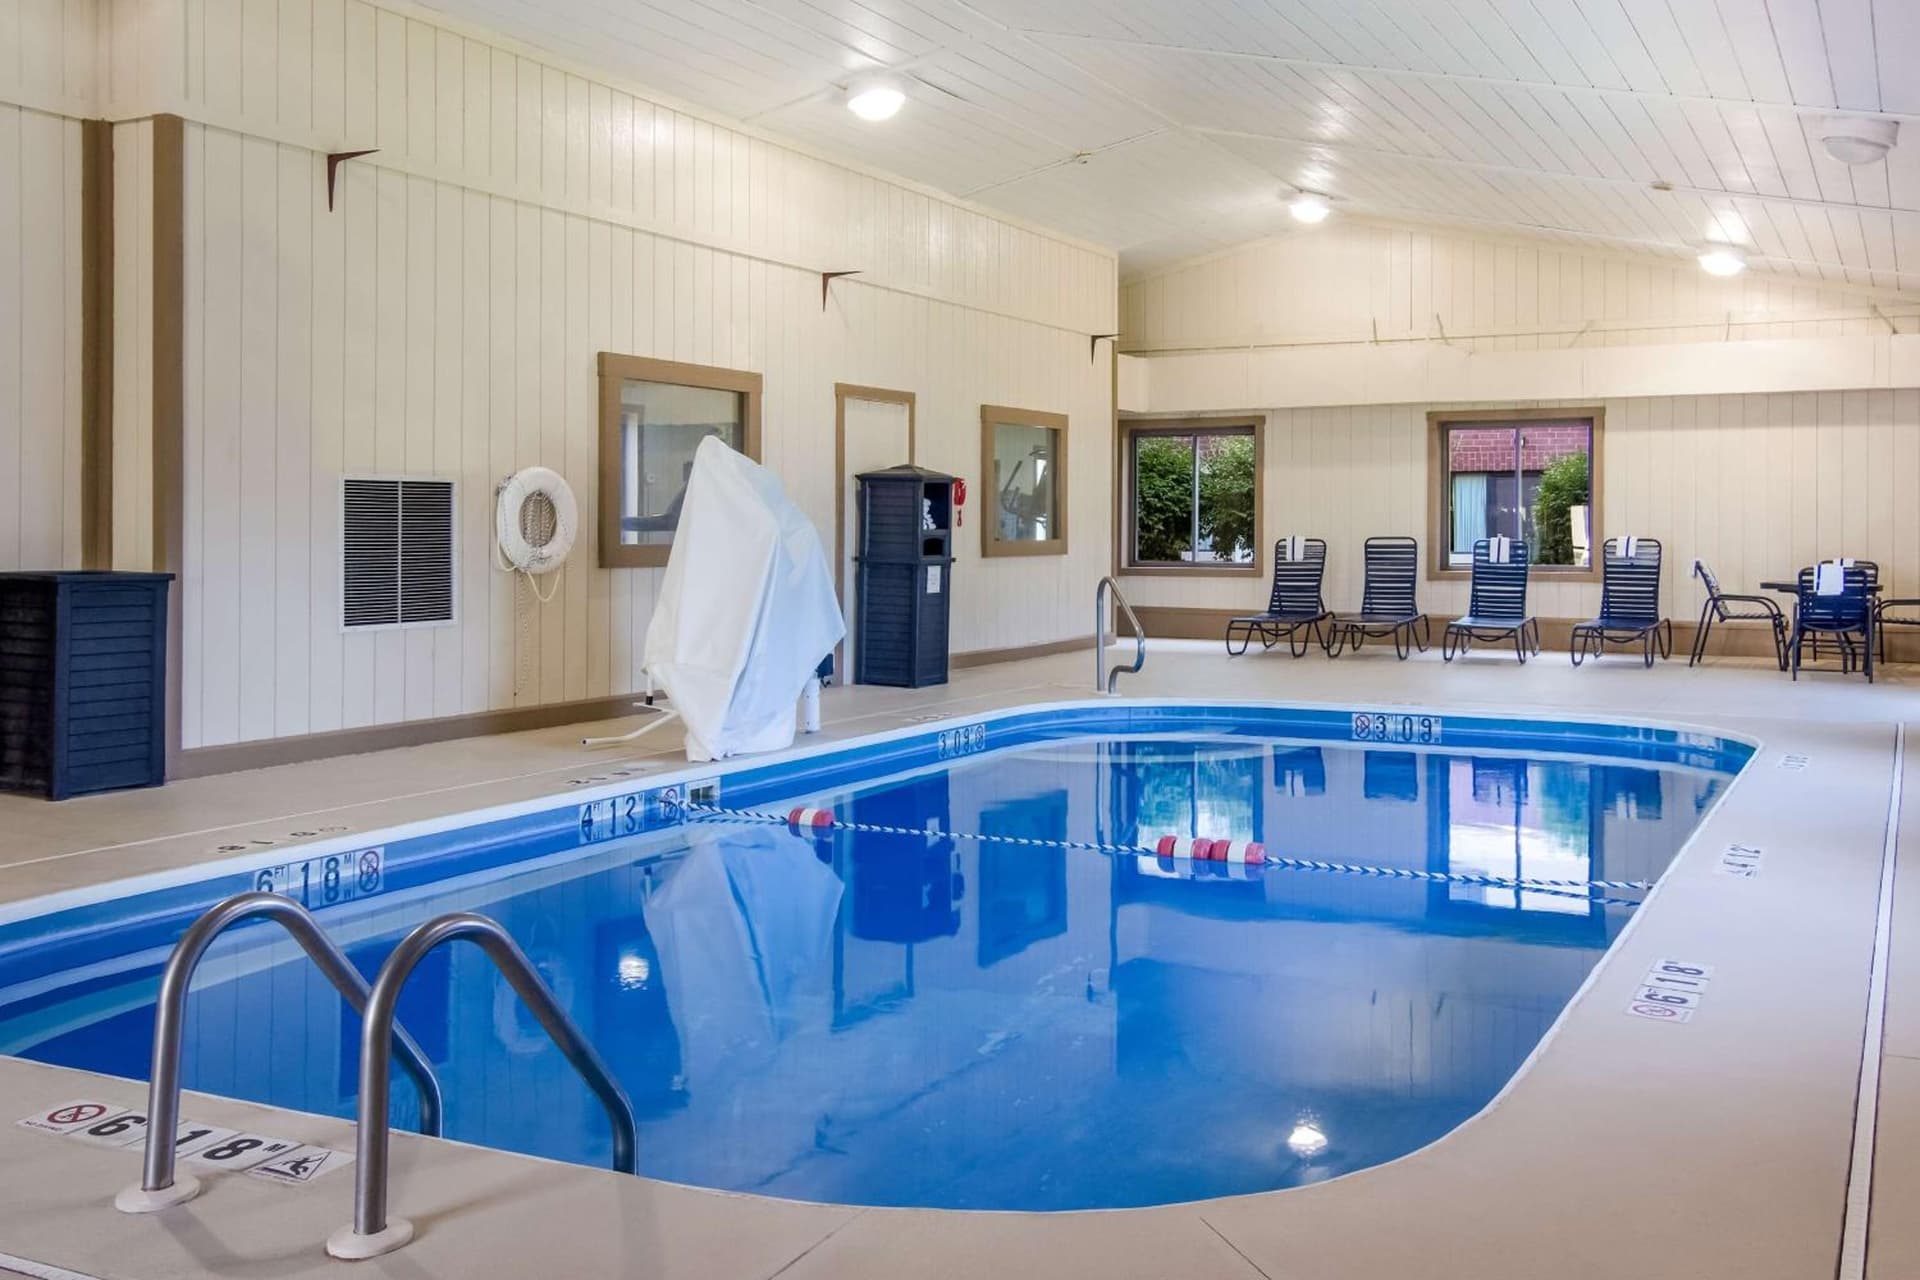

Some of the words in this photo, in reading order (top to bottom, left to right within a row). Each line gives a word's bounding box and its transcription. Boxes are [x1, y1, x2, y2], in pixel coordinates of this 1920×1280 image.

[257, 869, 273, 892] 6
[1644, 993, 1689, 1005] 6
[88, 1115, 147, 1136] 6
